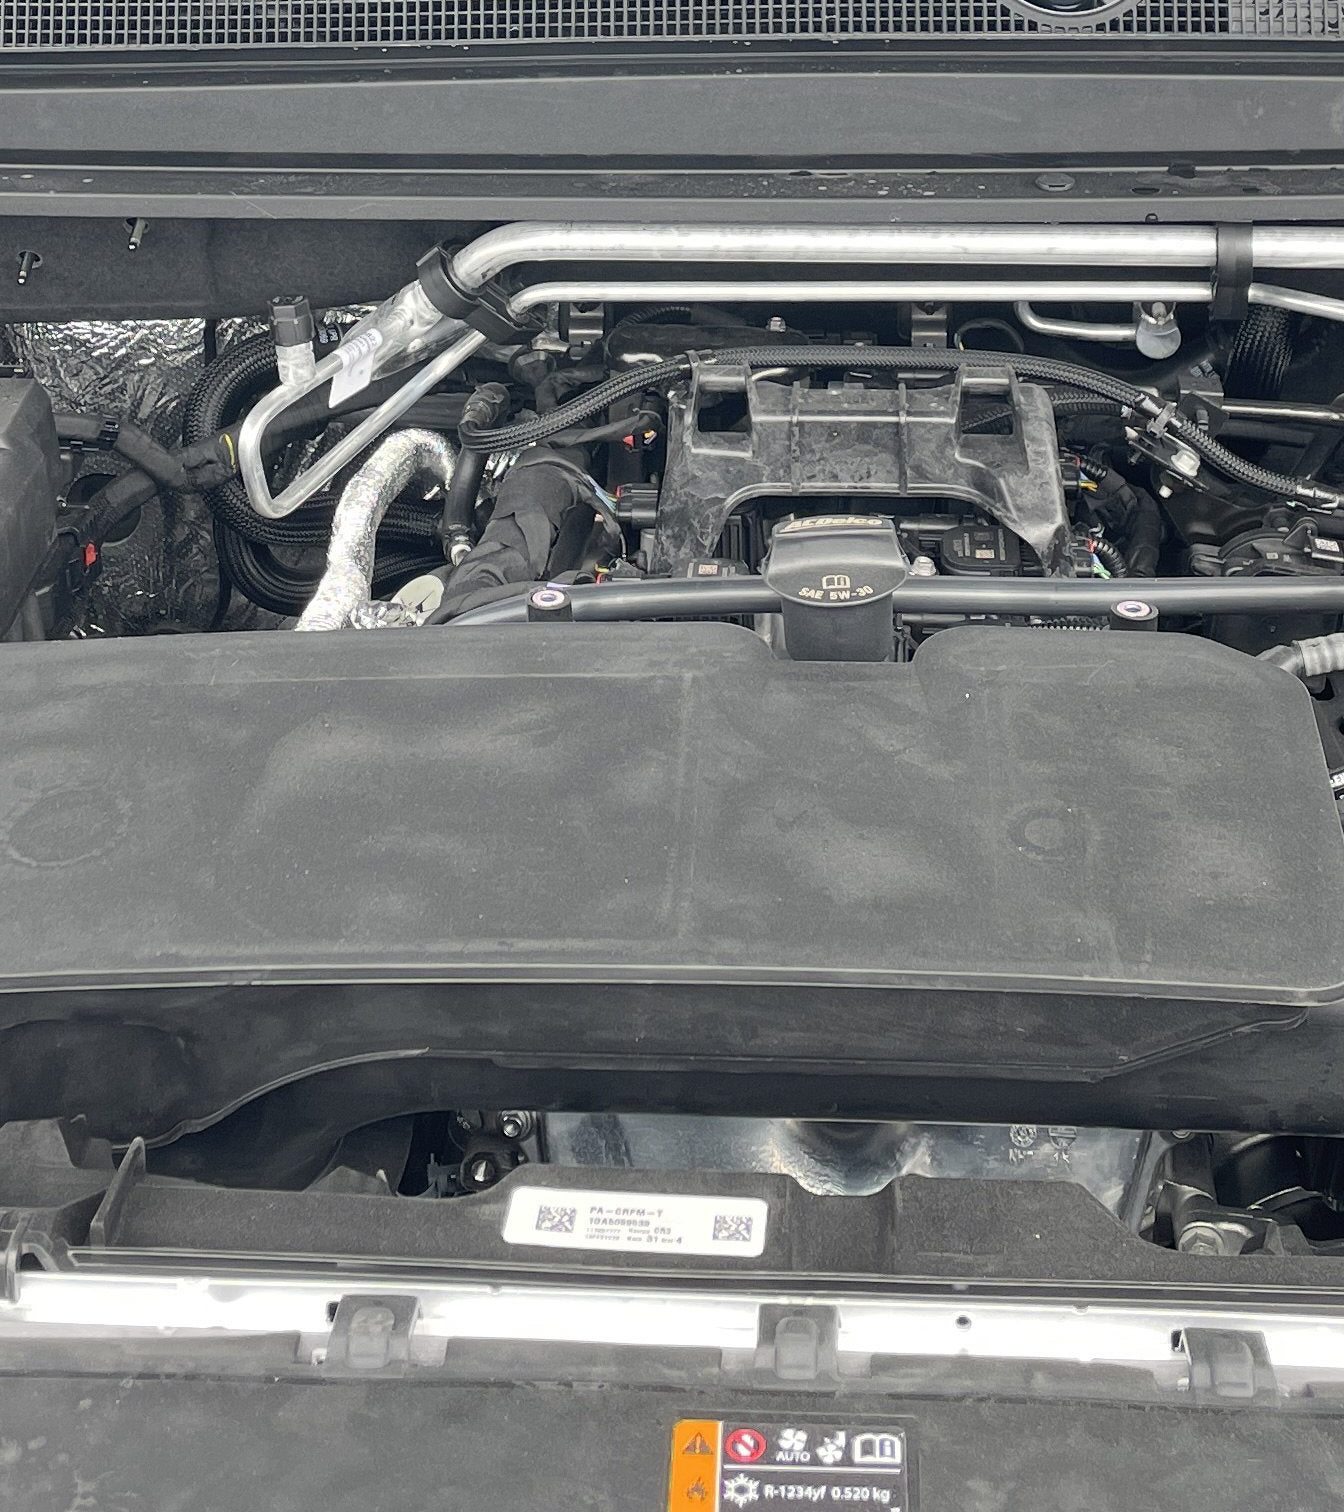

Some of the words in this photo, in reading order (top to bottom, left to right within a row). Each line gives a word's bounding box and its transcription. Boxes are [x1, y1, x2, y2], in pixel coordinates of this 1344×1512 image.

[782, 517, 883, 532] ACDelco
[798, 587, 824, 600] SAE
[829, 585, 874, 600] 5W-30
[776, 1450, 810, 1462] AUTO
[764, 1483, 826, 1501] R-1234yf
[831, 1485, 870, 1500] 0.520
[872, 1486, 891, 1503] kg
